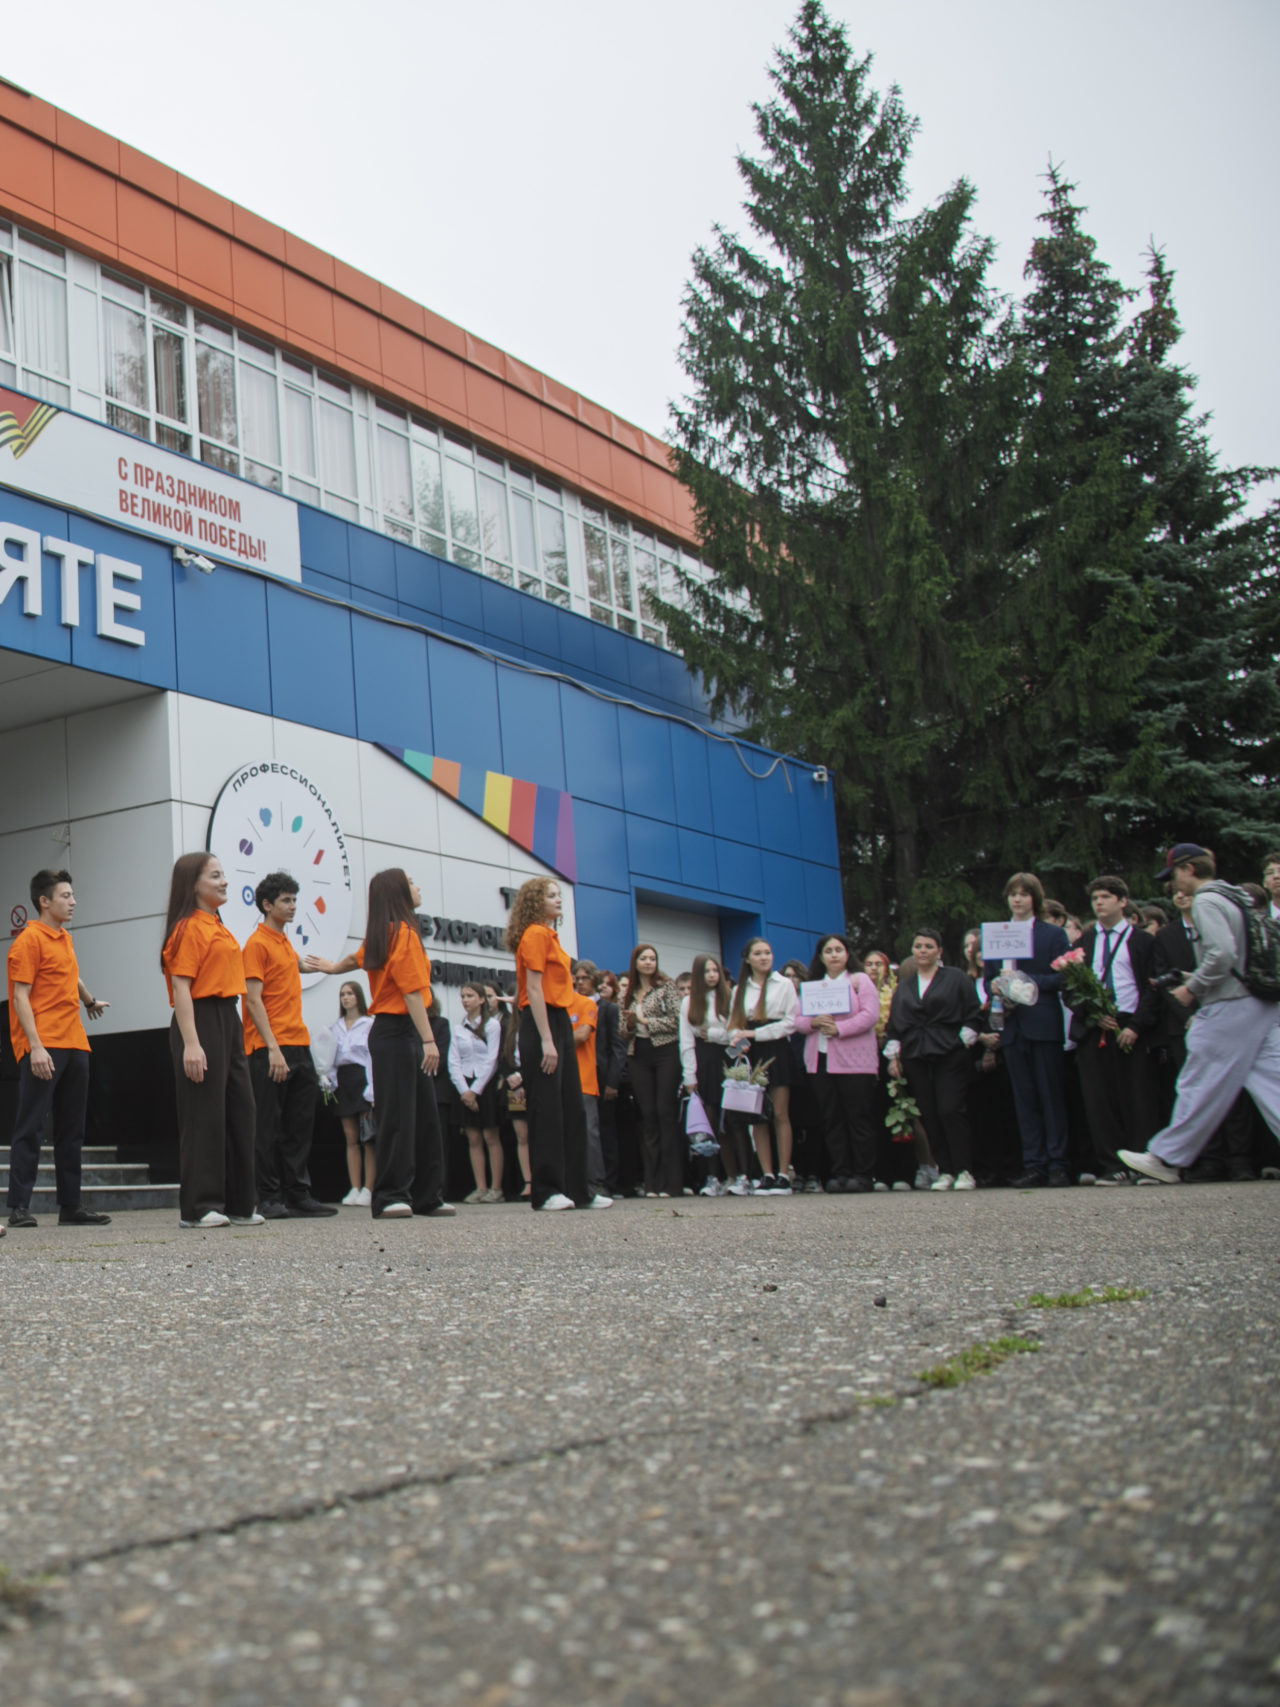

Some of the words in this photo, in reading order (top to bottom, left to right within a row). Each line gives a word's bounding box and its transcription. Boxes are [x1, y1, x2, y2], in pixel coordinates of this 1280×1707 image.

[117, 456, 128, 481] С
[133, 462, 242, 524] ПРАЗДНИКОМ
[119, 487, 194, 537] ВЕЛИКОЙ
[198, 517, 267, 563] ПОБЕДЫ!
[232, 762, 351, 892] ПРОФЕССИОНАЛИТЕТ
